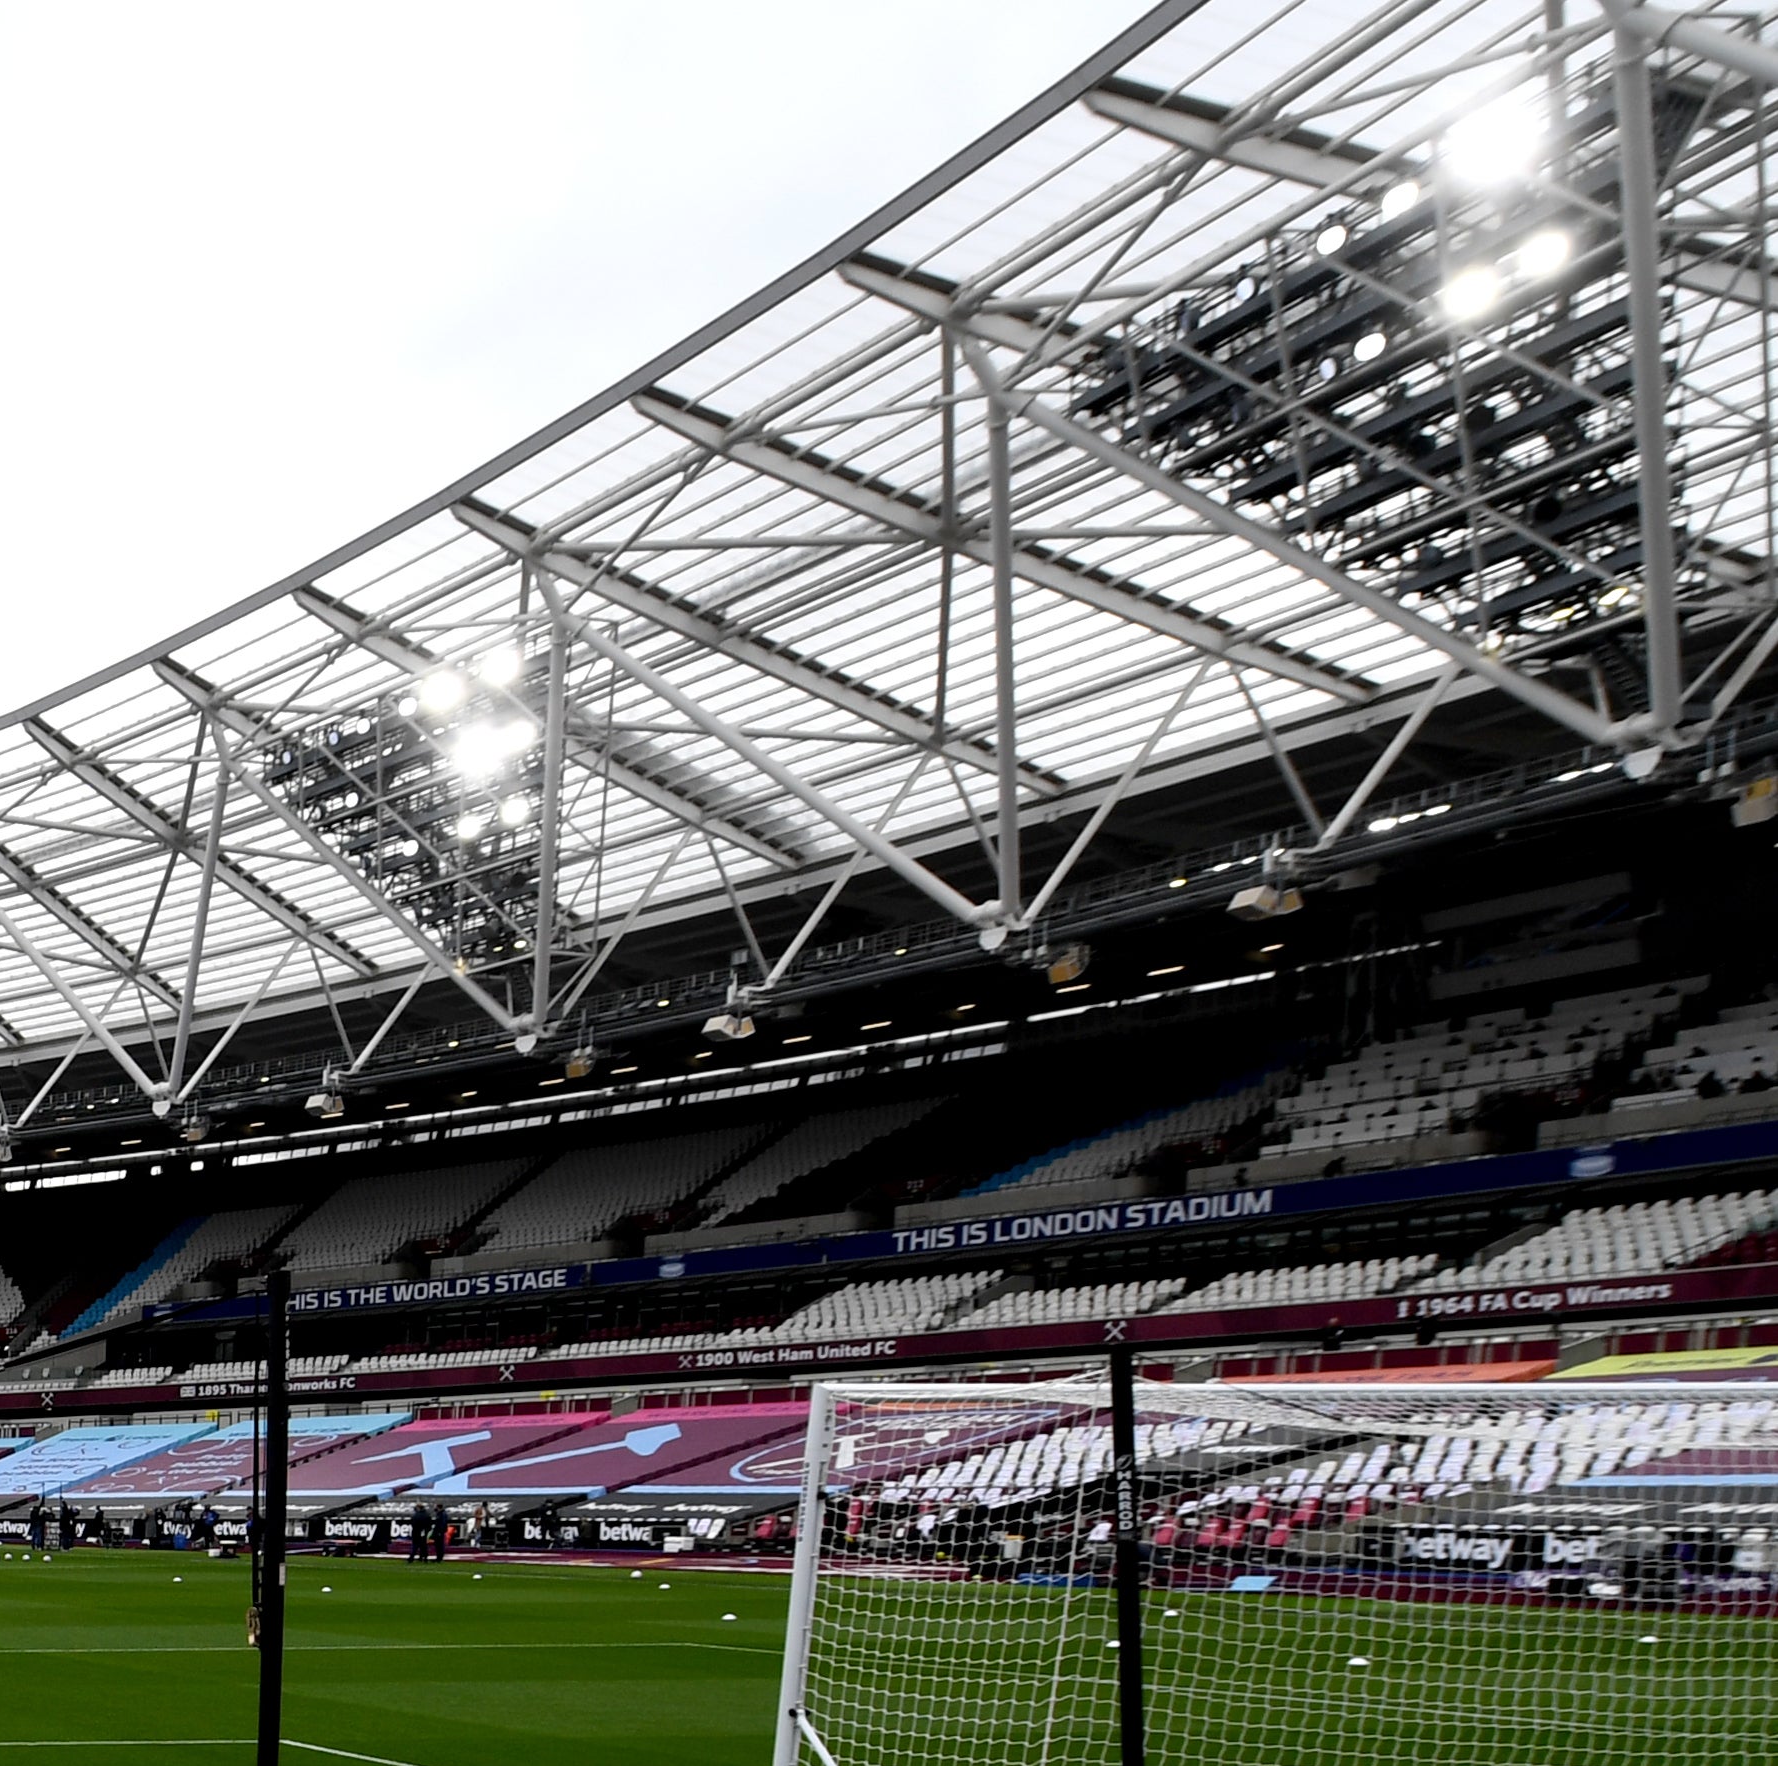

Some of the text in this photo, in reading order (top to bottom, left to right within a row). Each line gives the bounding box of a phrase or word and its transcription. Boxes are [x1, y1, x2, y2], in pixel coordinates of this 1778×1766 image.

[892, 1189, 1274, 1253] THIS IS LONDON STADIUM
[289, 1268, 567, 1310] HIS IS THE WORLD'S STAGE
[1416, 1283, 1673, 1317] 1964 FA Cup Winners
[696, 1340, 896, 1367] 1900 West Ham United FC
[197, 1384, 227, 1396] 1895
[339, 1377, 356, 1389] FC
[1116, 1470, 1134, 1531] HARROD
[163, 1522, 194, 1539] tway
[324, 1519, 377, 1541] betway
[599, 1521, 653, 1541] betwa
[1401, 1529, 1601, 1569] betway bet
